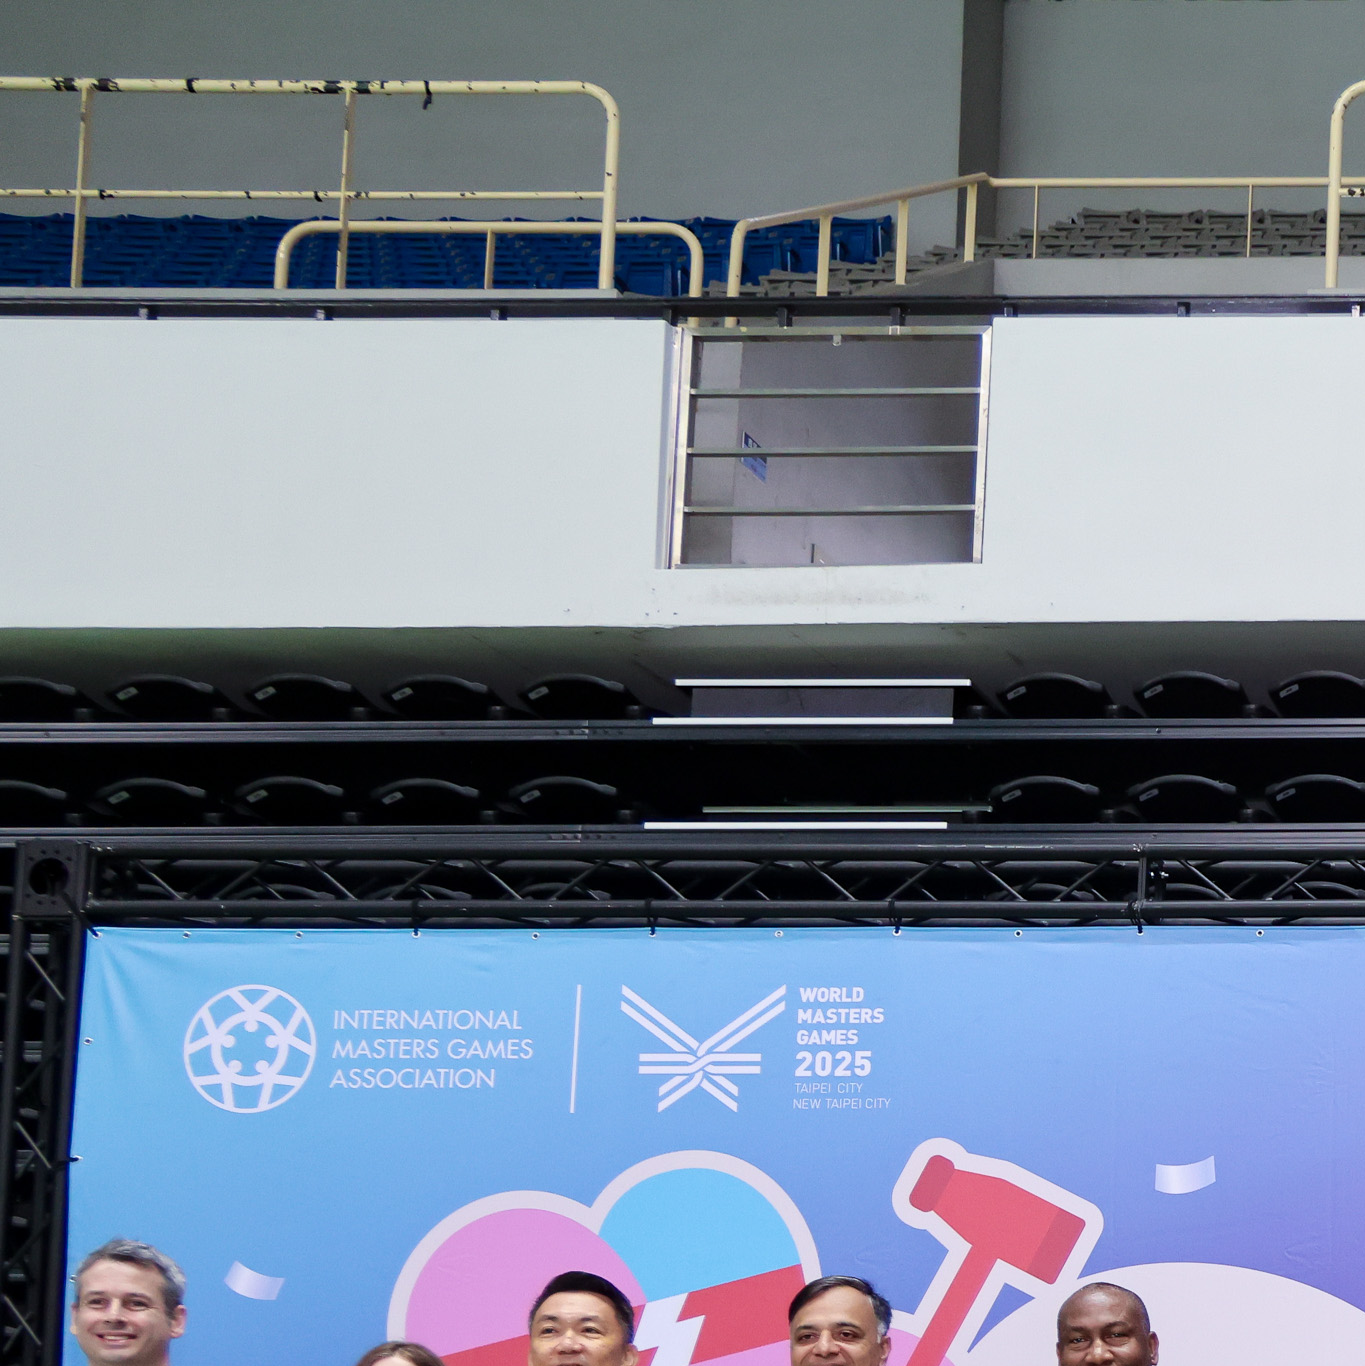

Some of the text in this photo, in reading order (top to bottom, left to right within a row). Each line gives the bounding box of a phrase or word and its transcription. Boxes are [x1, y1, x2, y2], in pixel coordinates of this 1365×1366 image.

[799, 987, 865, 1003] WORLD
[333, 1009, 523, 1030] INTERNATIONAL
[797, 1007, 885, 1025] MASTERS
[796, 1028, 859, 1046] GAMES
[332, 1038, 534, 1060] MASTERS GAMES
[793, 1050, 872, 1078] 2025
[329, 1067, 496, 1089] ASSOCIATION
[794, 1082, 863, 1094] TAIPEI CITY
[792, 1098, 892, 1110] NEW TAIPEI CITY
